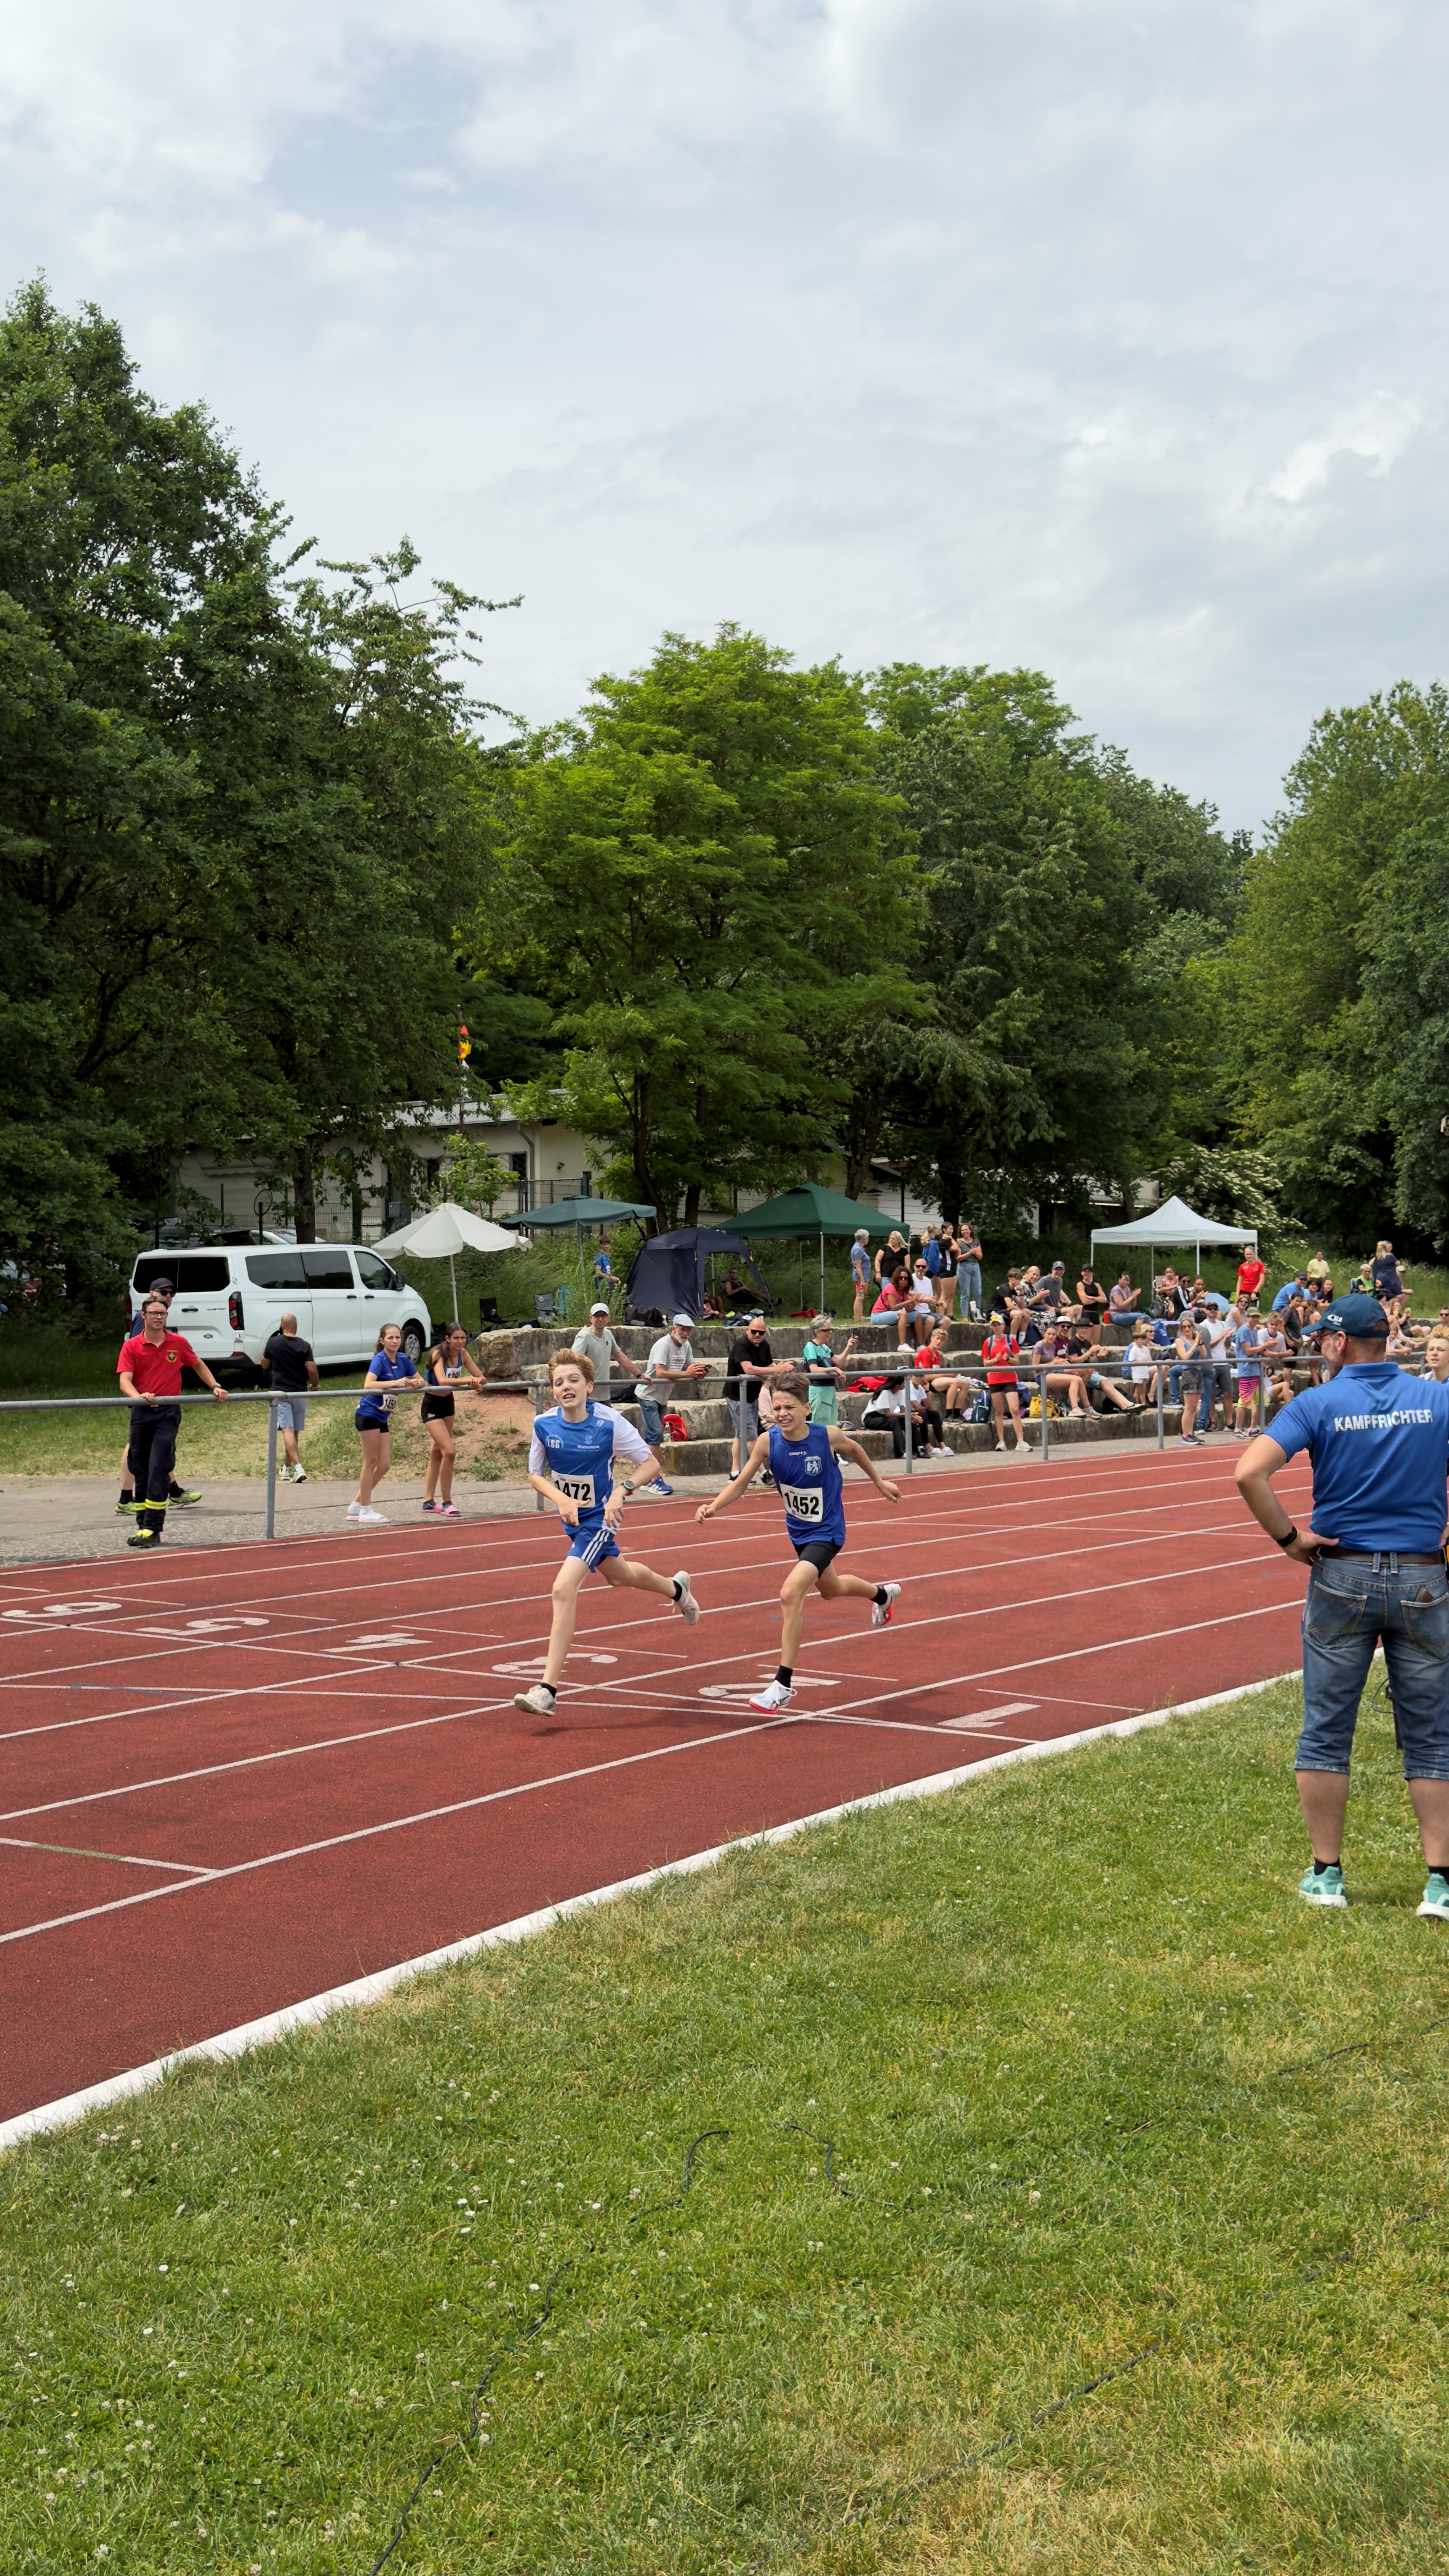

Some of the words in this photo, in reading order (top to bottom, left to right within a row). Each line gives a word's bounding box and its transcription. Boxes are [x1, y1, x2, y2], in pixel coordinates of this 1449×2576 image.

[1334, 1409, 1433, 1432] KAMPFRICHTER
[547, 1439, 560, 1449] LSG
[555, 1480, 591, 1501] 1472
[784, 1492, 819, 1515] 1452
[135, 1617, 270, 1635] 5
[319, 1633, 433, 1653] 4
[936, 1702, 1042, 1728] 1
